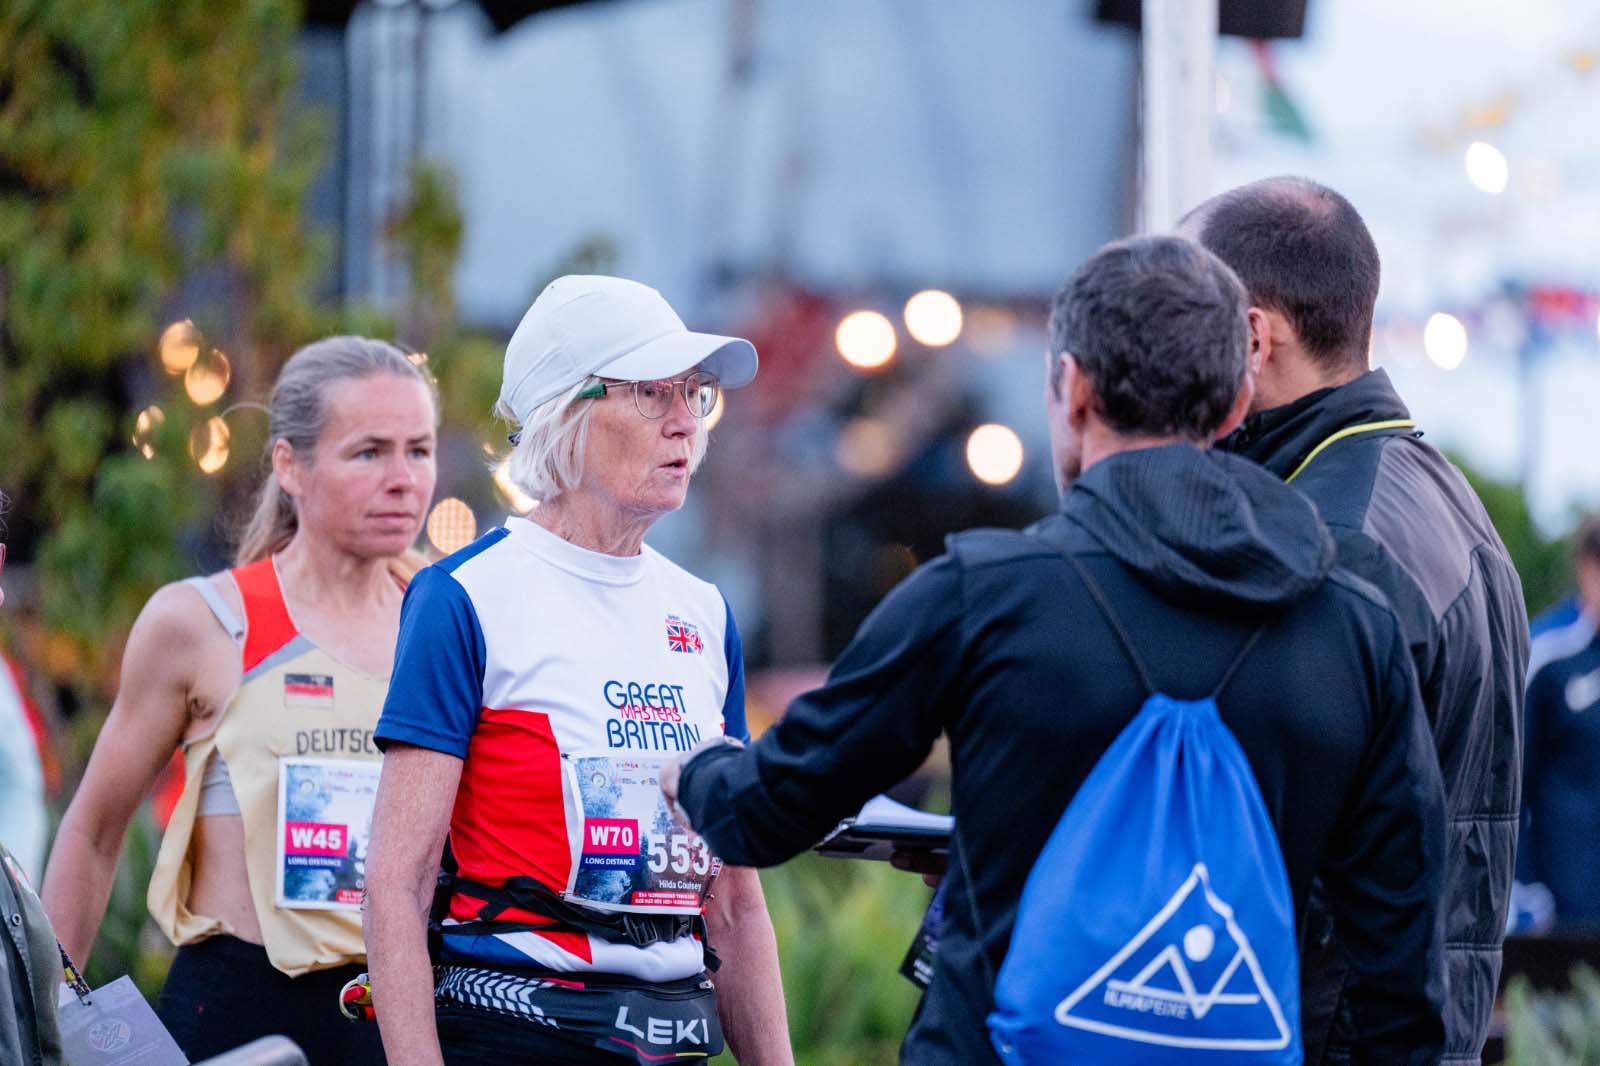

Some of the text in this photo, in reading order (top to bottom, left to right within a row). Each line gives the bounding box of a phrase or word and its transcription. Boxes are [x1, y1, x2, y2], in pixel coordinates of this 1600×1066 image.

[603, 680, 686, 713] GREAT
[620, 704, 682, 722] MASTERS
[296, 728, 381, 755] DEUTSC
[606, 718, 701, 752] BRITAIN
[291, 827, 342, 850] W45
[590, 825, 633, 847] W70
[287, 856, 341, 867] LONG DISTANCE
[585, 857, 636, 866] LONG DISTANCE
[647, 834, 710, 876] 553
[659, 879, 676, 889] Hilda
[615, 1006, 709, 1045] LEKI
